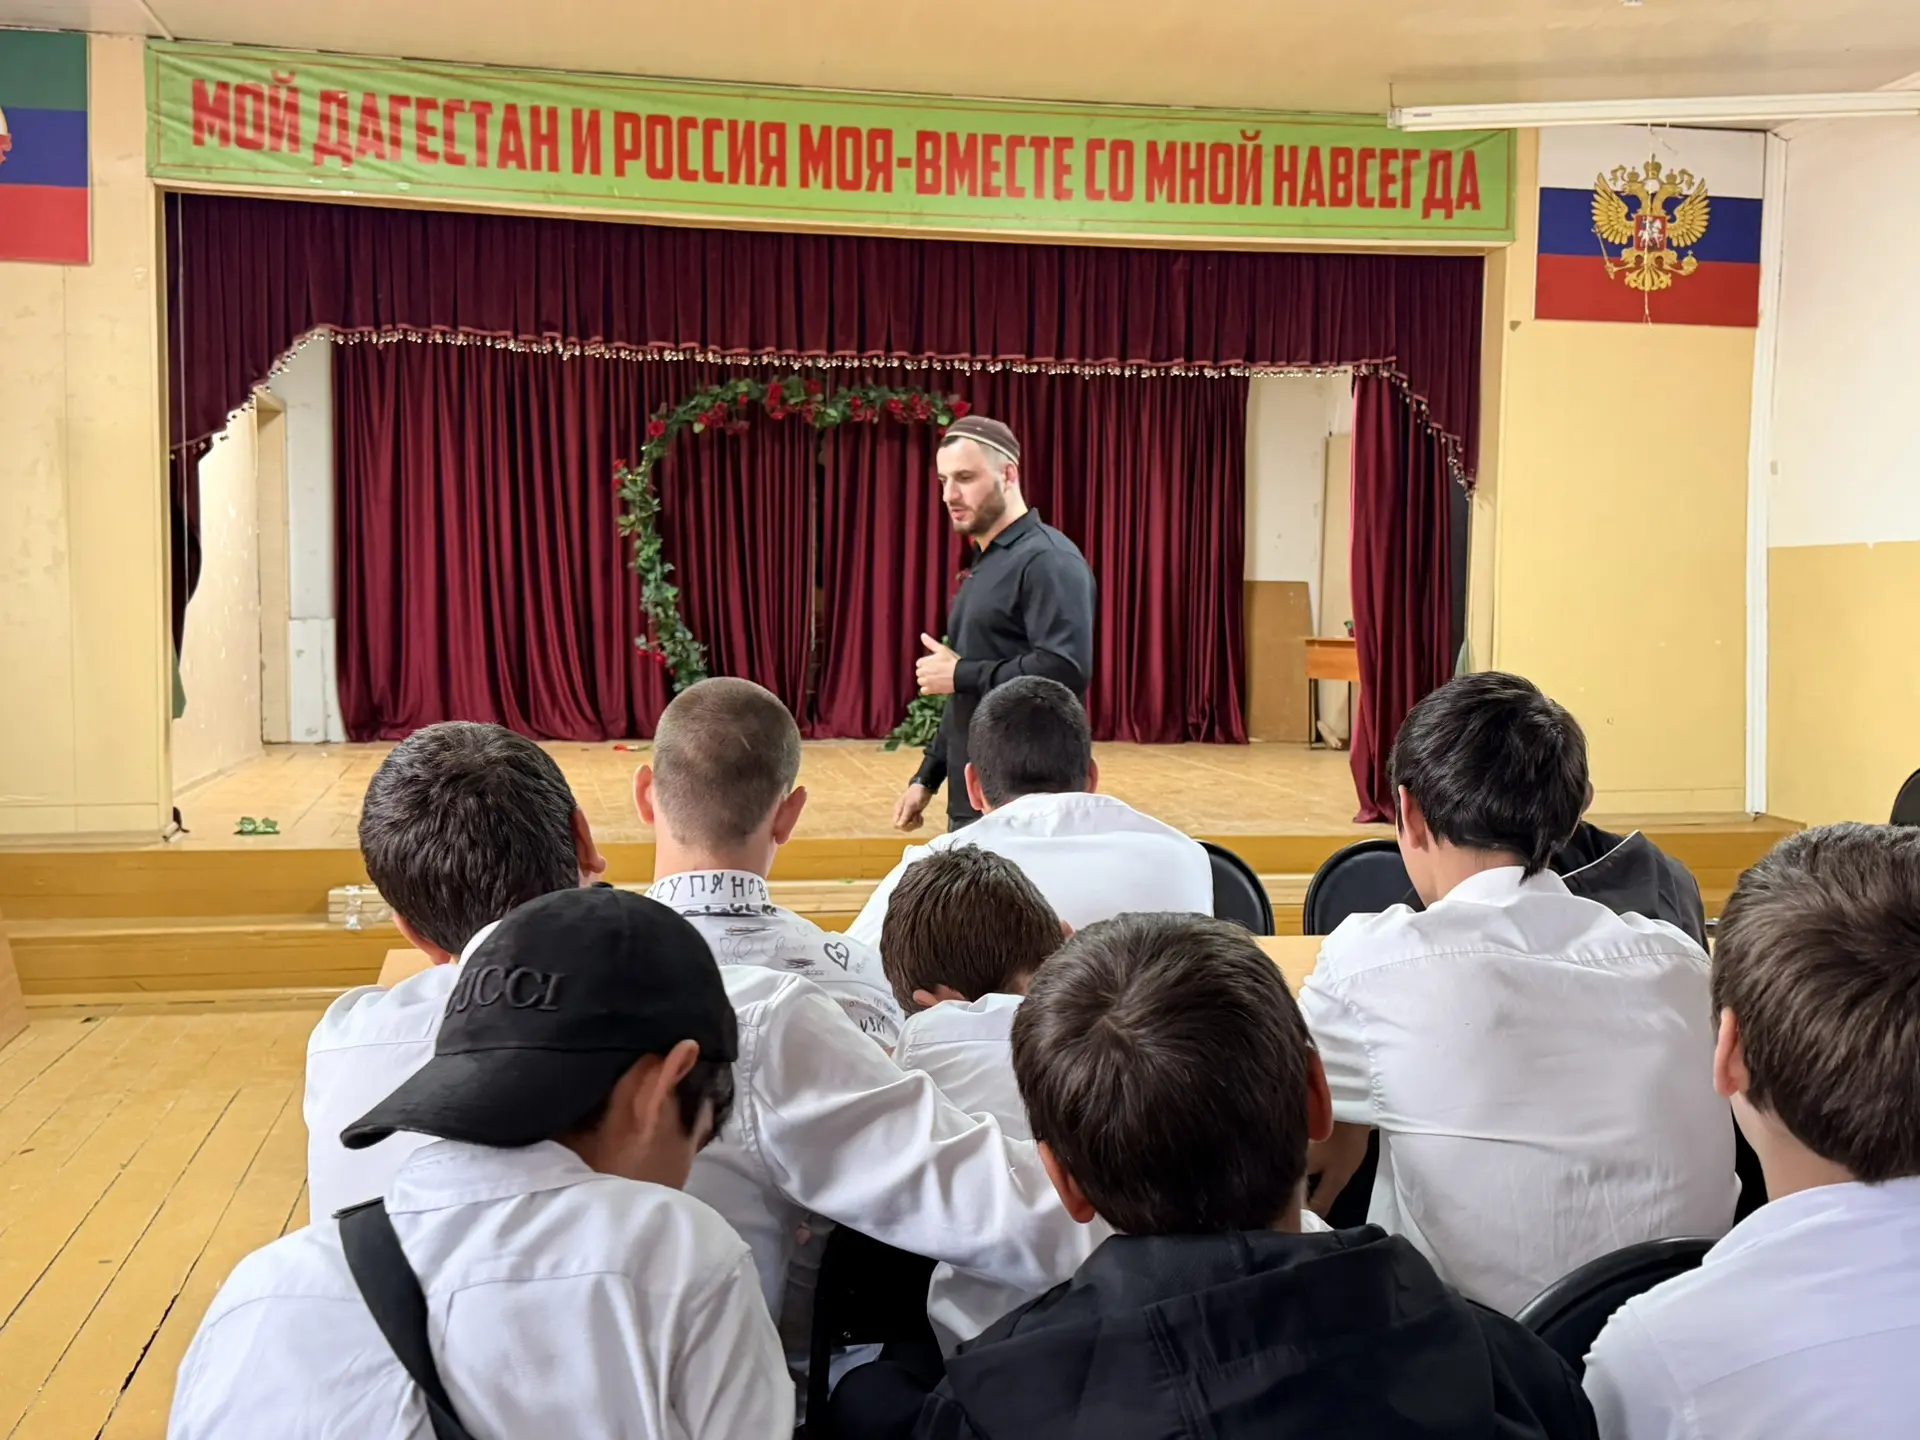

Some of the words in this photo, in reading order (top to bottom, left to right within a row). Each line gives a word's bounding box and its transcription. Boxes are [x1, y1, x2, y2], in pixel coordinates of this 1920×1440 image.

[192, 71, 301, 154] МОЙ
[313, 90, 560, 175] ДАГЕСТАН
[571, 108, 602, 176] И
[613, 111, 788, 188] РОССИЯ
[1085, 138, 1135, 203] СО
[1145, 130, 1264, 206] МНОЙ
[1273, 145, 1481, 220] НАВСЕГДА
